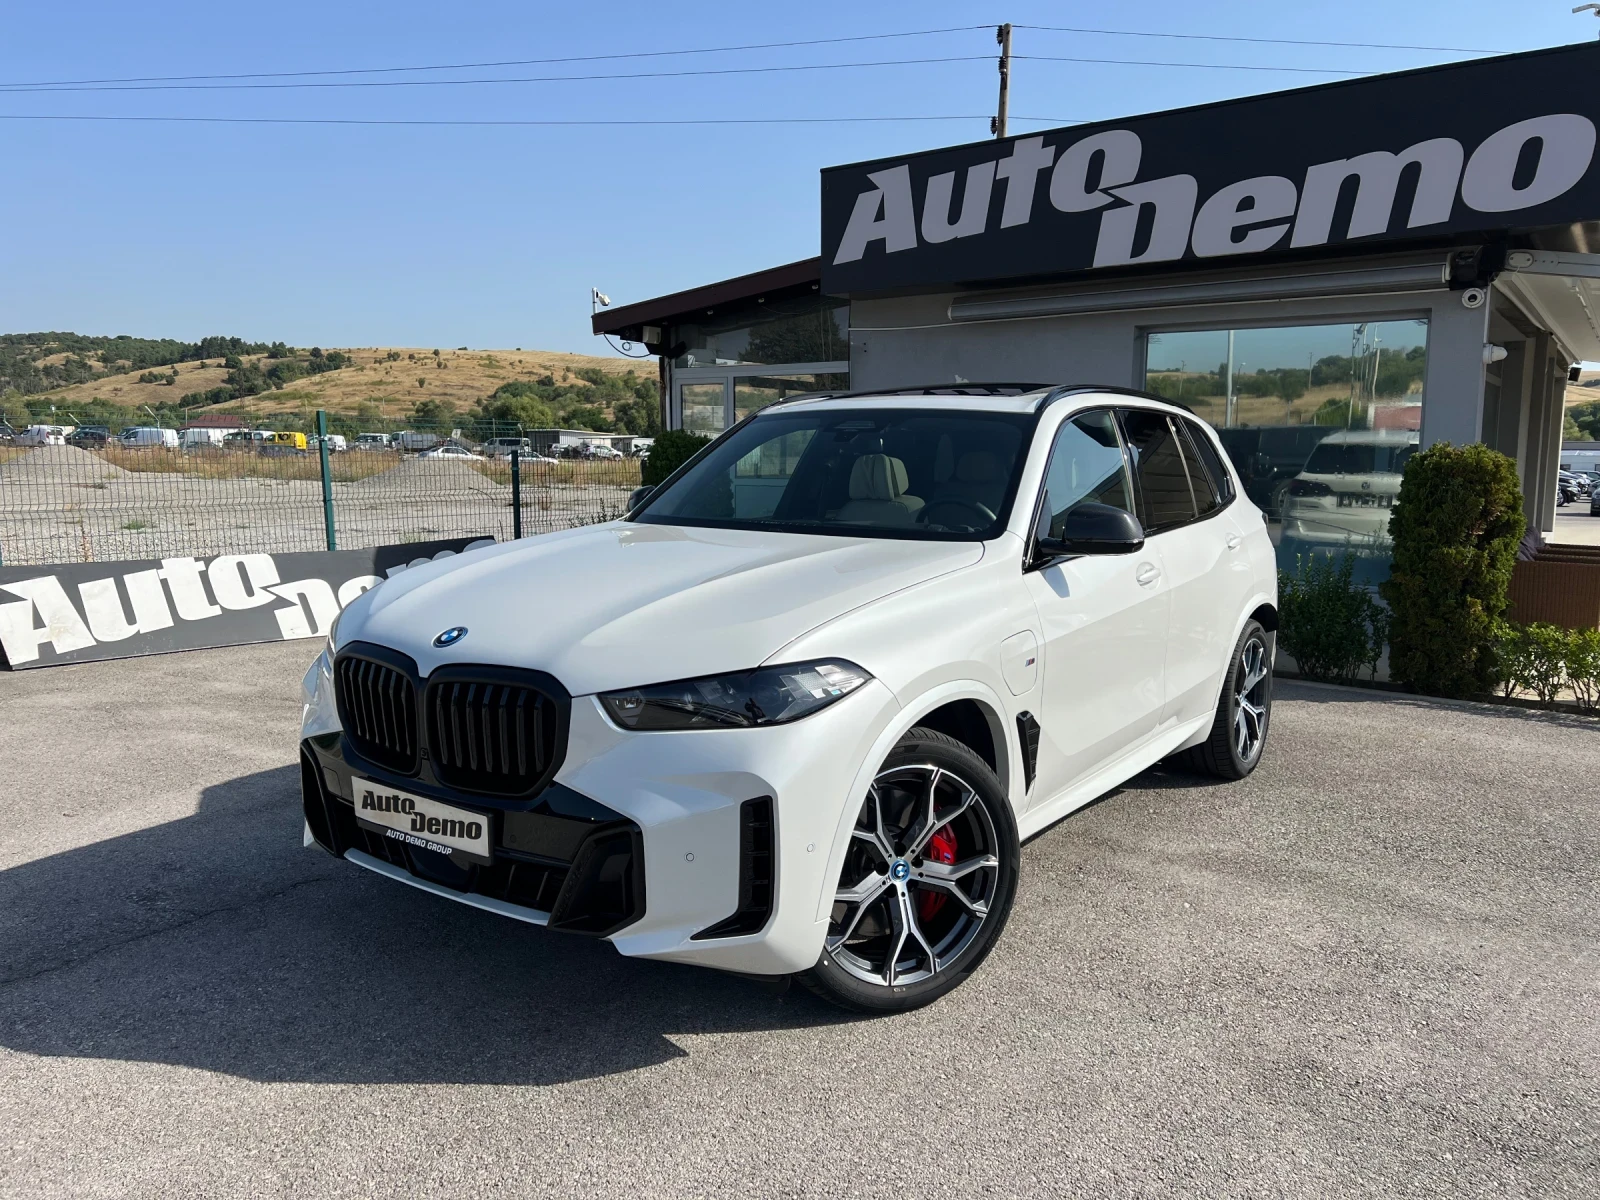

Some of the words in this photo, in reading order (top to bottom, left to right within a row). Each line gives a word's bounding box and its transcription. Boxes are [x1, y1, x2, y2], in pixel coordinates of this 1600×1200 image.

[832, 130, 1143, 266] Auto
[1093, 113, 1597, 268] Demo
[0, 553, 281, 665] Auto
[361, 789, 415, 815] Auto
[411, 811, 482, 840] Demo
[386, 829, 405, 841] AUTO
[405, 834, 426, 848] DEMO
[427, 841, 453, 855] GROUP
